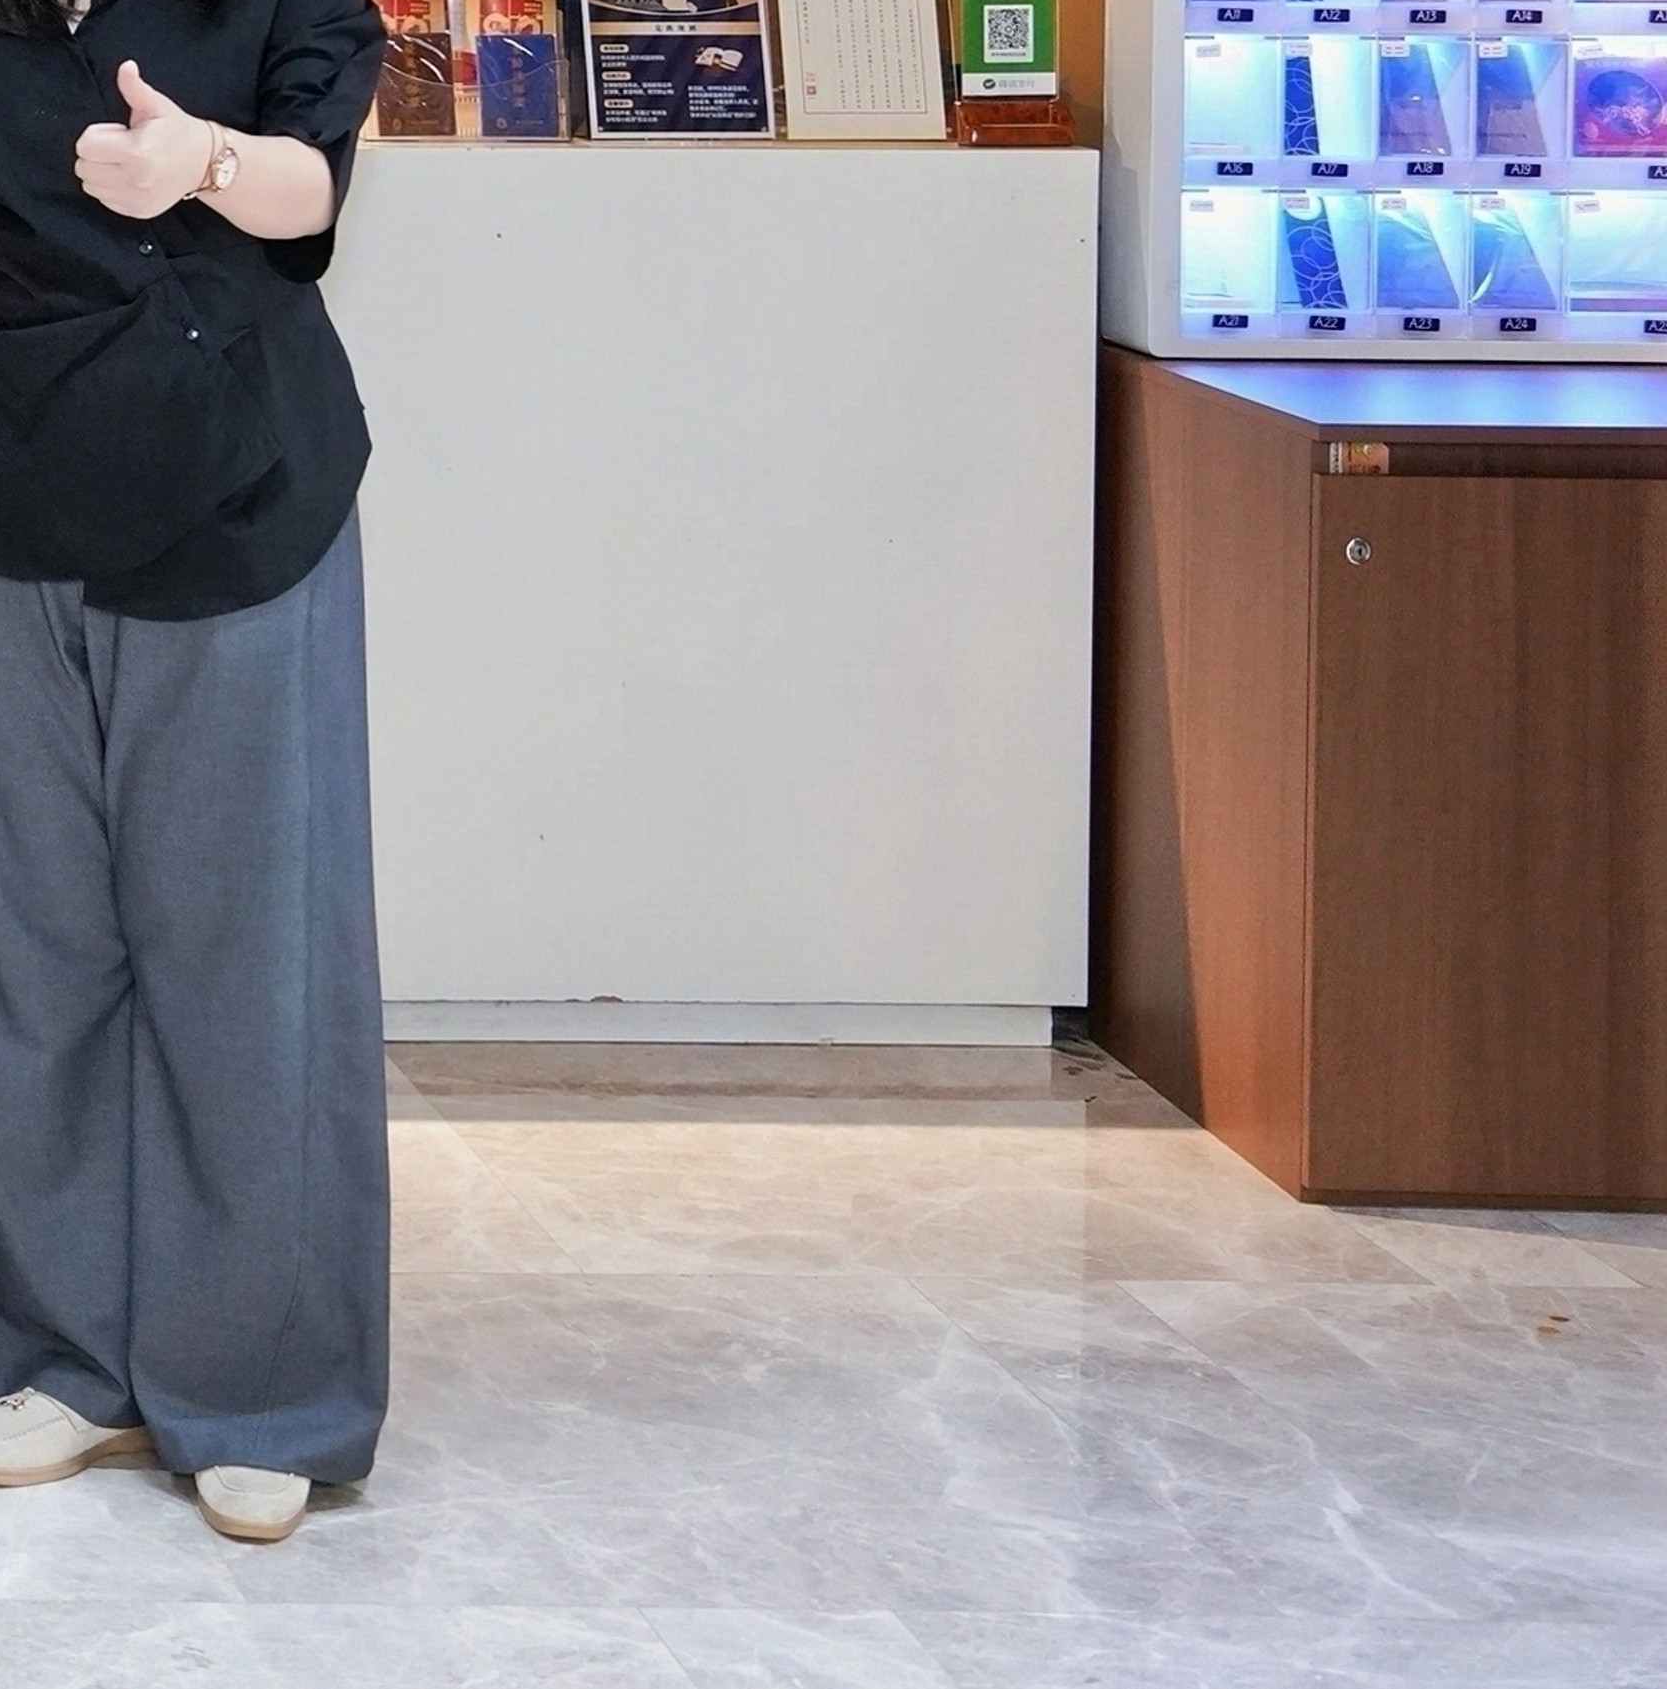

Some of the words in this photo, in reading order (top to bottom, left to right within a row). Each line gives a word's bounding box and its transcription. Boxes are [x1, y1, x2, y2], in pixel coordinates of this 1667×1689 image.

[1320, 10, 1340, 21] A12
[1416, 11, 1436, 22] A13
[1513, 11, 1532, 22] A14
[1224, 163, 1243, 174] A16
[1318, 164, 1337, 175] A17
[1414, 163, 1433, 174] A18
[1511, 164, 1531, 175] A19
[1219, 315, 1239, 326] A21
[1314, 316, 1337, 329] A22
[1410, 318, 1432, 330] A23
[1506, 319, 1527, 330] A24
